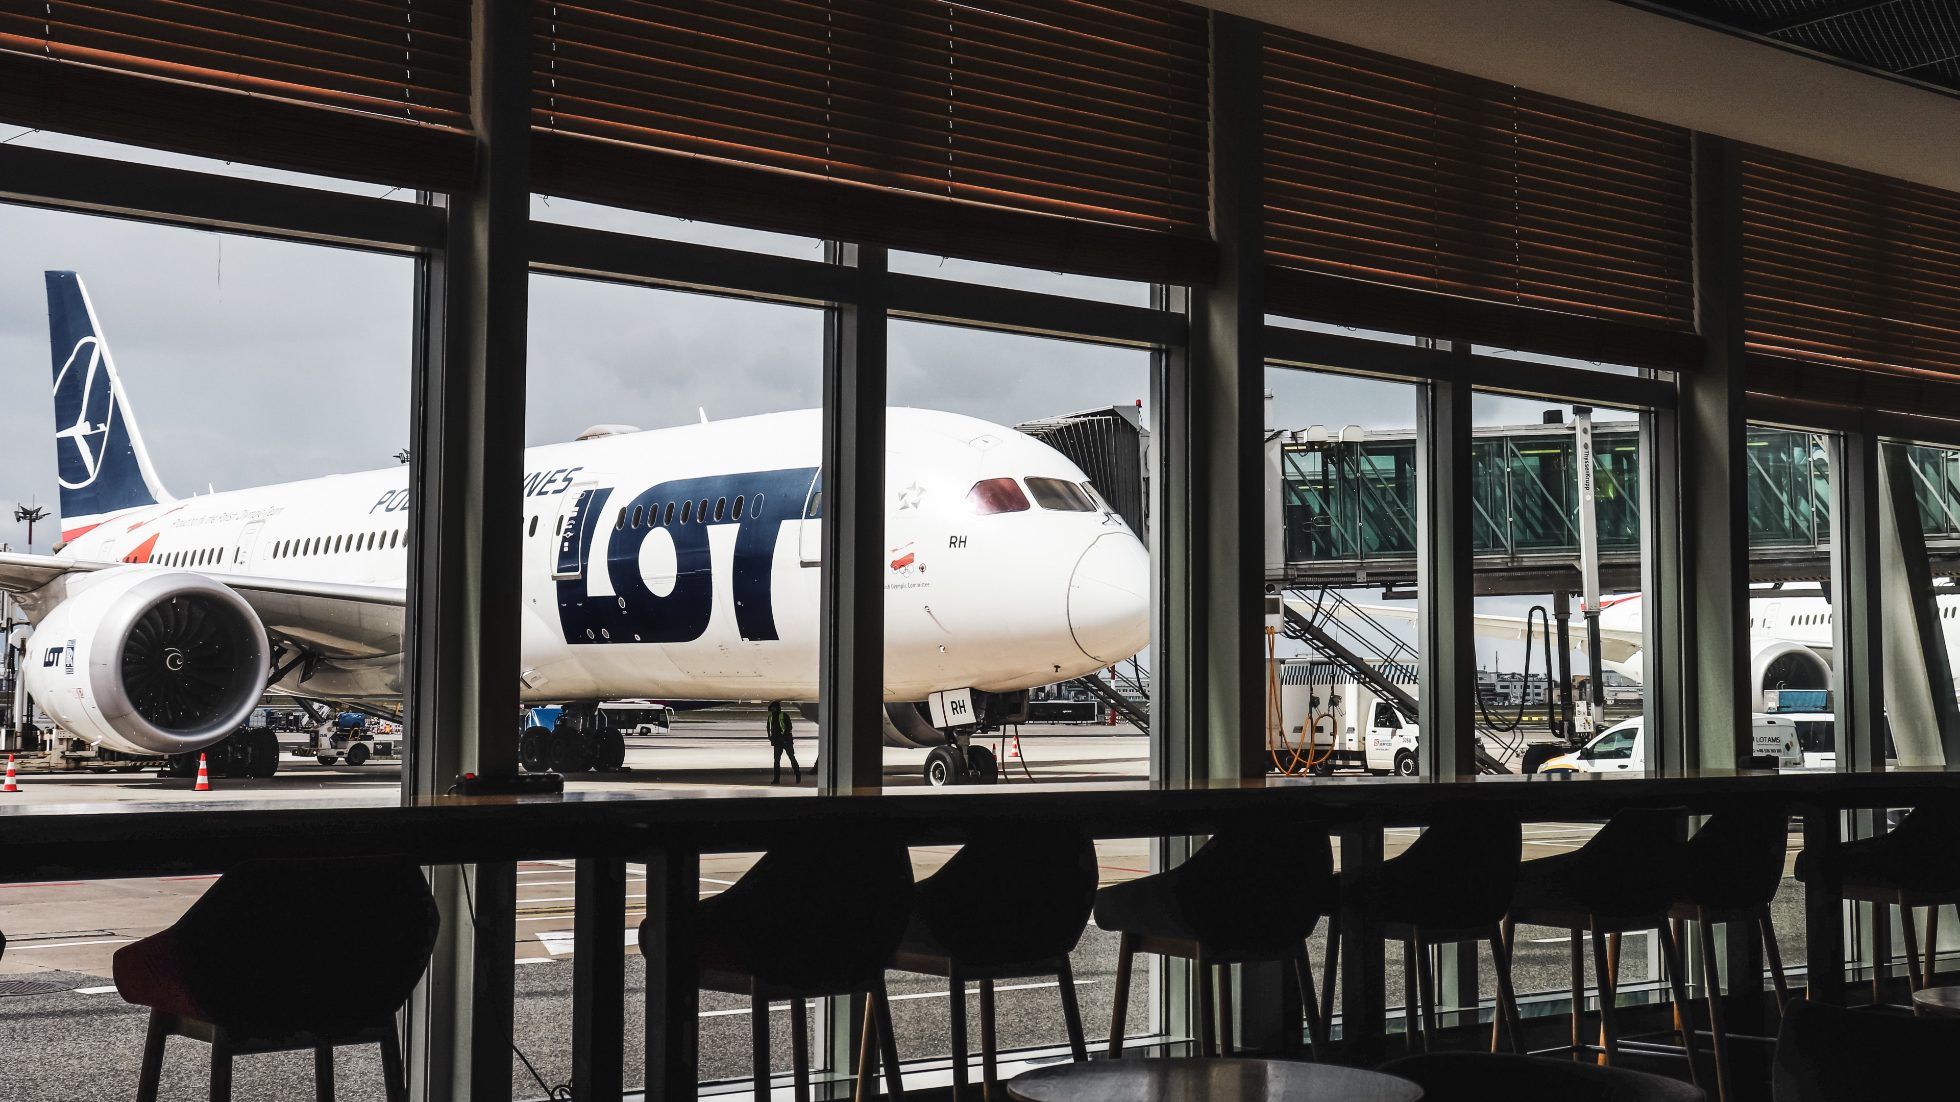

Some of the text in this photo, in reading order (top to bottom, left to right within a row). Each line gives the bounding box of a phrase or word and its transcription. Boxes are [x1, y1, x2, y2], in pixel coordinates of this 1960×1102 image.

[949, 535, 967, 549] RH
[556, 466, 822, 645] LOT
[43, 647, 64, 667] LOT
[950, 699, 967, 715] RH
